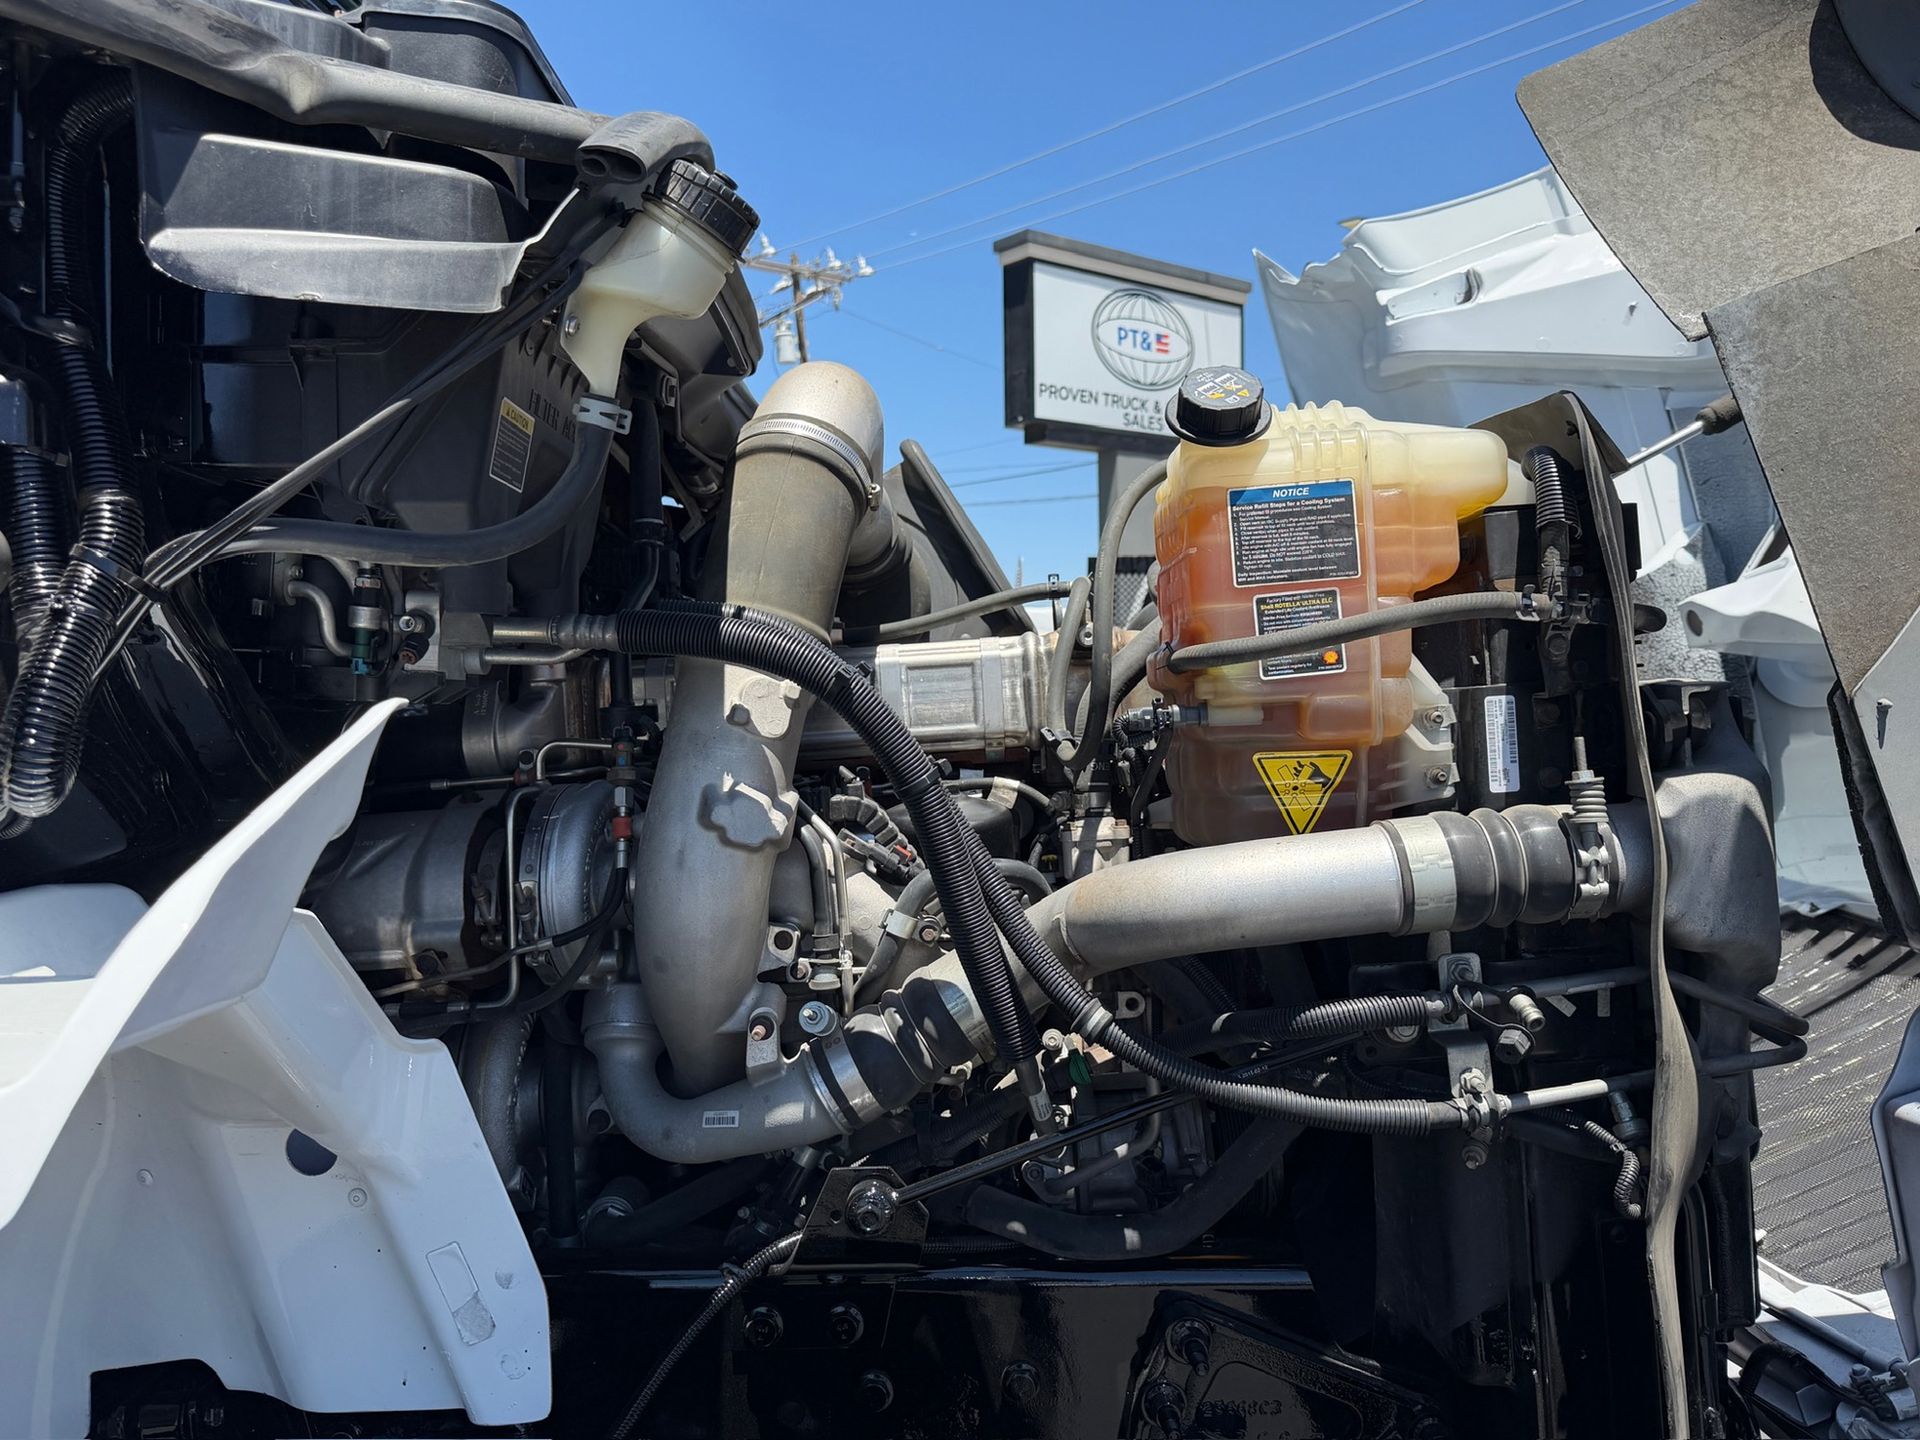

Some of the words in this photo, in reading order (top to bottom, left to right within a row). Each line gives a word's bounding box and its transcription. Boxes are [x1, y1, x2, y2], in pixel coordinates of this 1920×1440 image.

[1117, 326, 1170, 355] PT&E
[528, 388, 560, 431] FILTER
[1038, 383, 1099, 405] PROVEN
[1103, 392, 1149, 413] TRUCK
[1153, 400, 1162, 414] &
[1122, 414, 1164, 432] SALES
[1272, 487, 1309, 497] NOTICE
